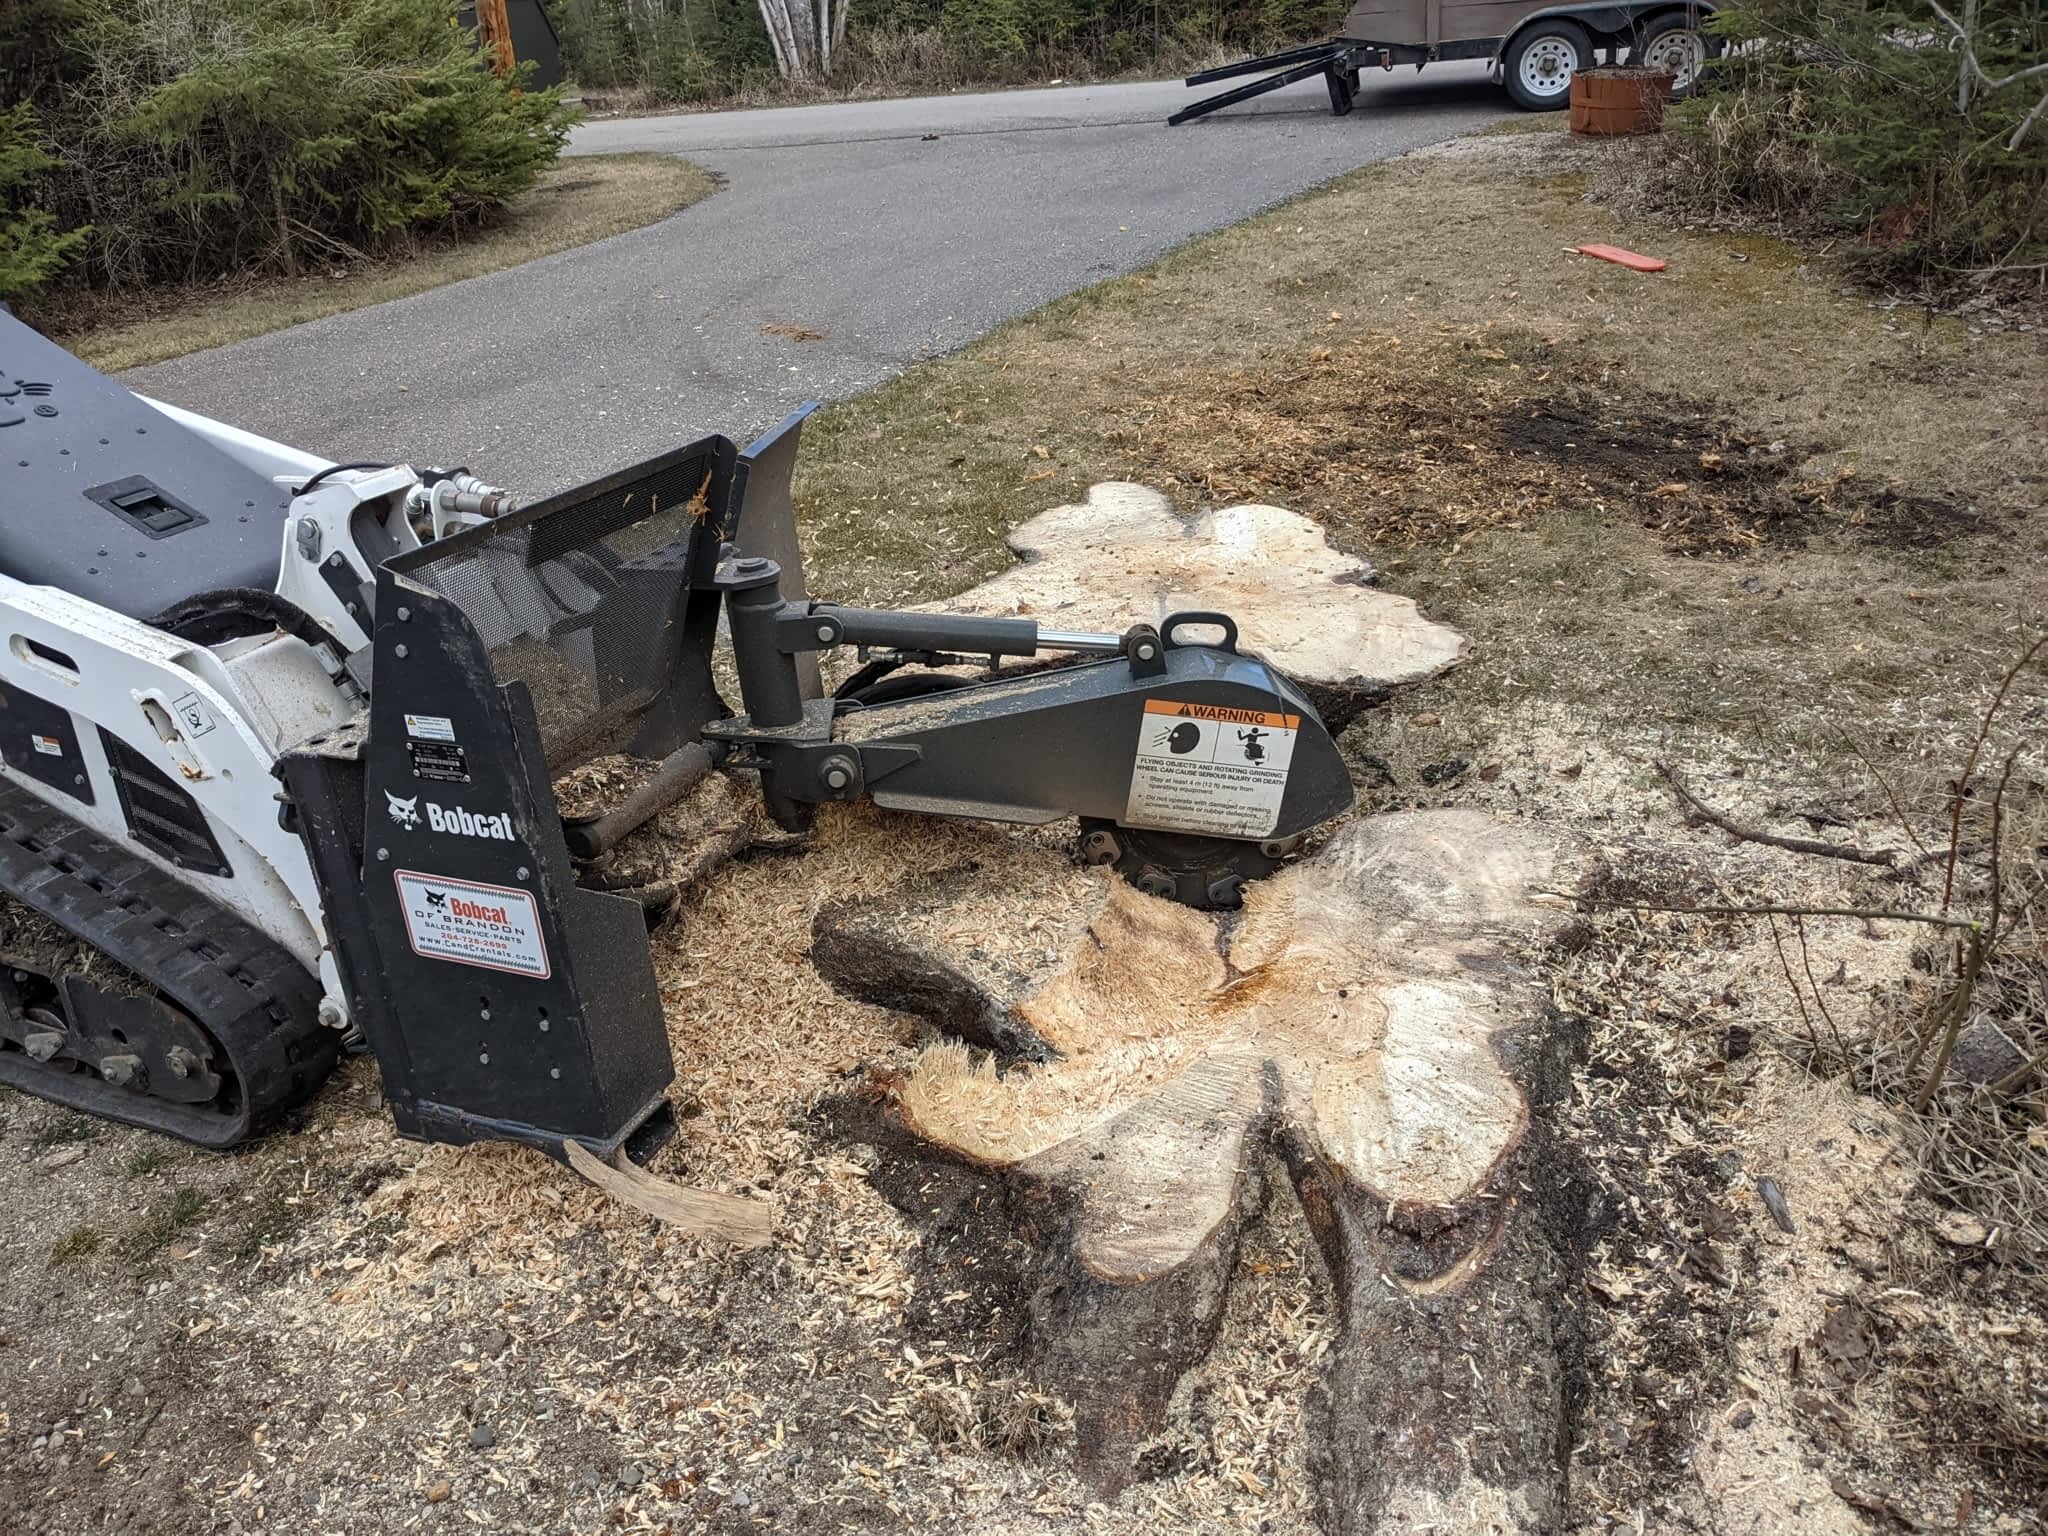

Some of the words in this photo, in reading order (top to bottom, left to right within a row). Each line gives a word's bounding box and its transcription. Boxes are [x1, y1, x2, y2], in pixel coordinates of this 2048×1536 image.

[1194, 706, 1265, 724] WARNING
[1135, 764, 1159, 772] WHEEL
[1198, 771, 1226, 779] SERIOUS
[1165, 760, 1196, 768] OBJECTS
[1214, 765, 1248, 774] ROTATING
[1248, 769, 1282, 777] GRINDING
[426, 803, 515, 841] Bobcat
[450, 897, 508, 924] Bobcat
[414, 910, 435, 919] OF
[442, 915, 525, 935] BRANDON
